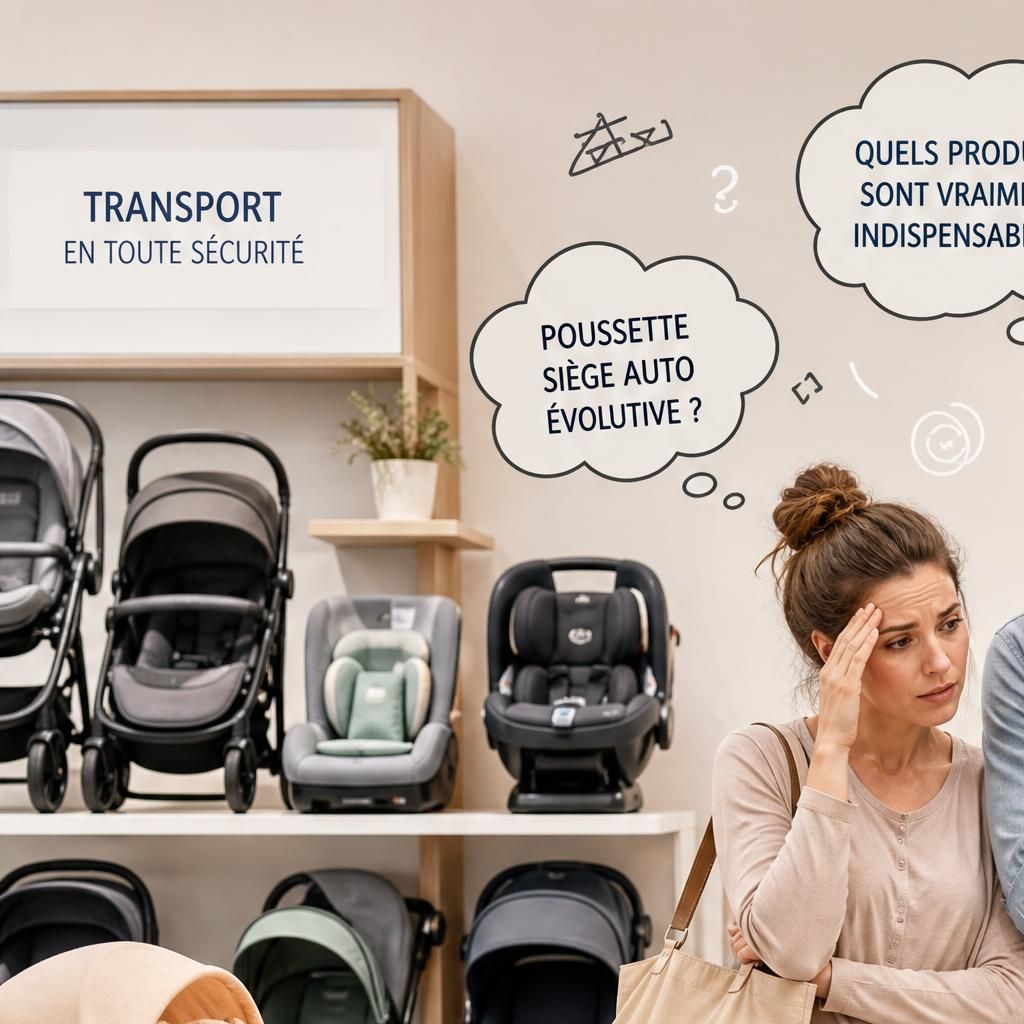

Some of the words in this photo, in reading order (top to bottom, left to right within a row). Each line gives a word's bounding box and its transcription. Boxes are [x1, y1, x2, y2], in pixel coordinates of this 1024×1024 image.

[83, 190, 282, 223] TRANSPORT
[64, 240, 95, 265] EN
[103, 240, 182, 265] TOUTE
[191, 233, 304, 265] SÉCURITÉ
